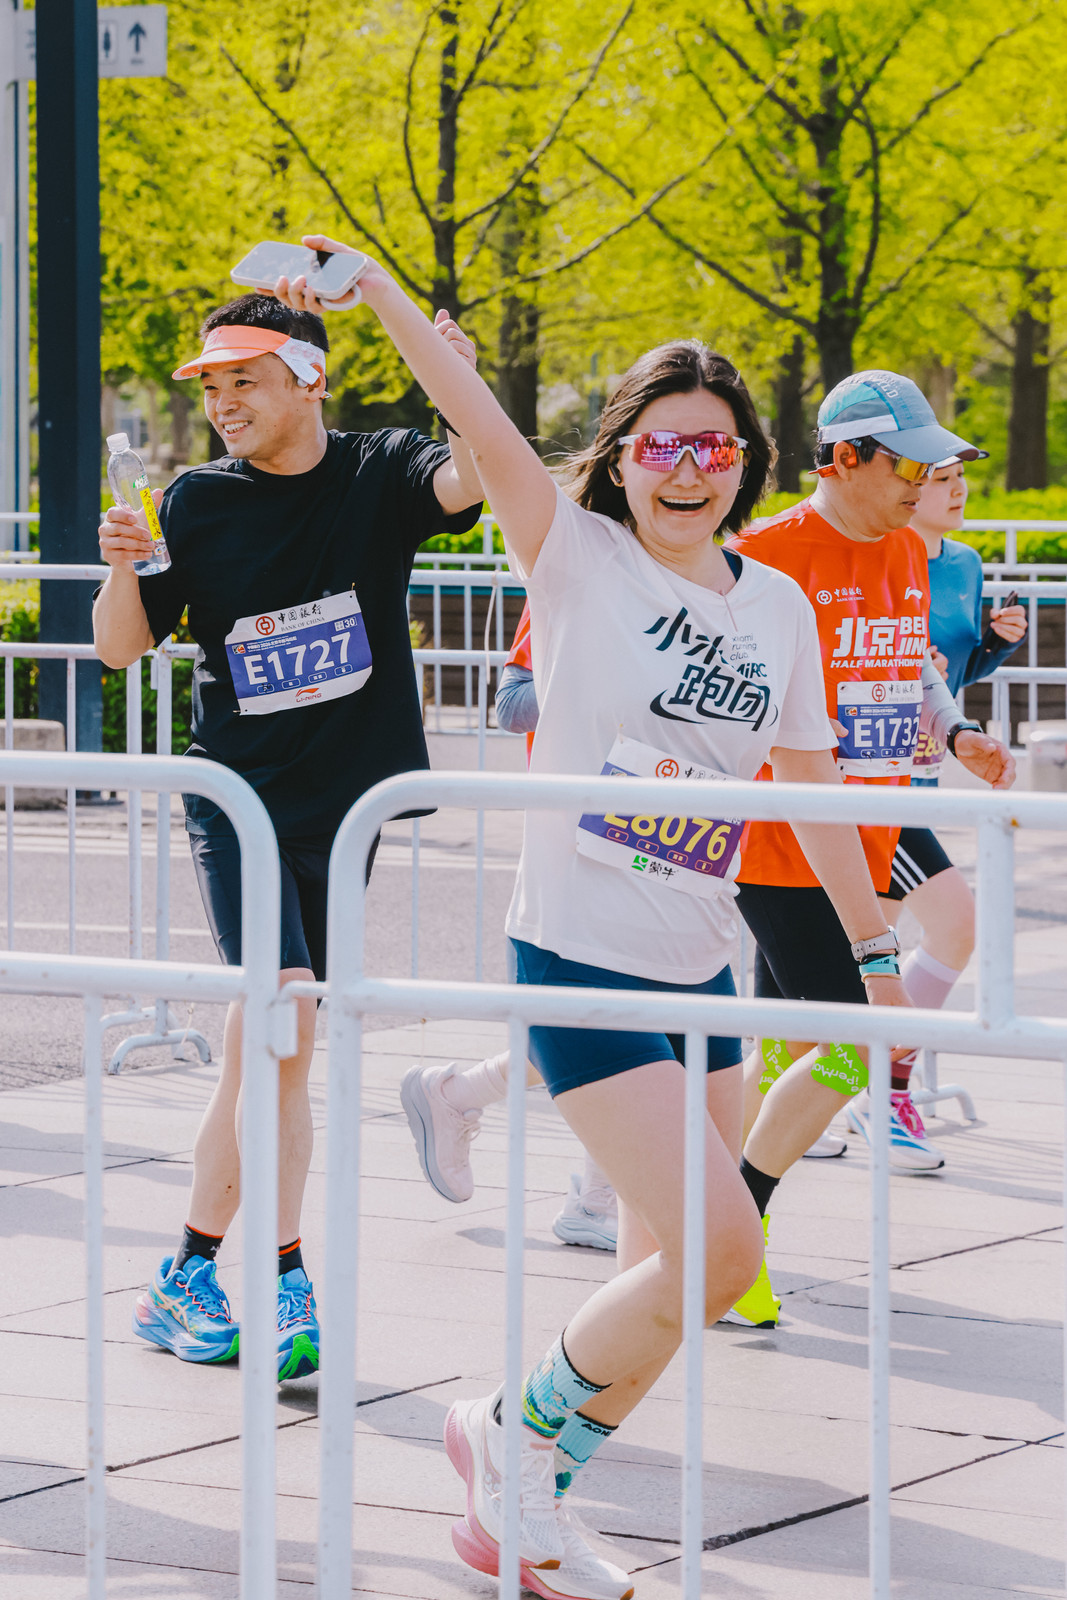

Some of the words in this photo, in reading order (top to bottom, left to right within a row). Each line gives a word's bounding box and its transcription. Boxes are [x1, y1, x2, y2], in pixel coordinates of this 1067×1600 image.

[278, 603, 322, 625] 中国银行
[832, 616, 899, 658] 北京
[243, 632, 351, 686] E1727
[830, 660, 864, 669] HALF
[667, 664, 771, 731] 跑团
